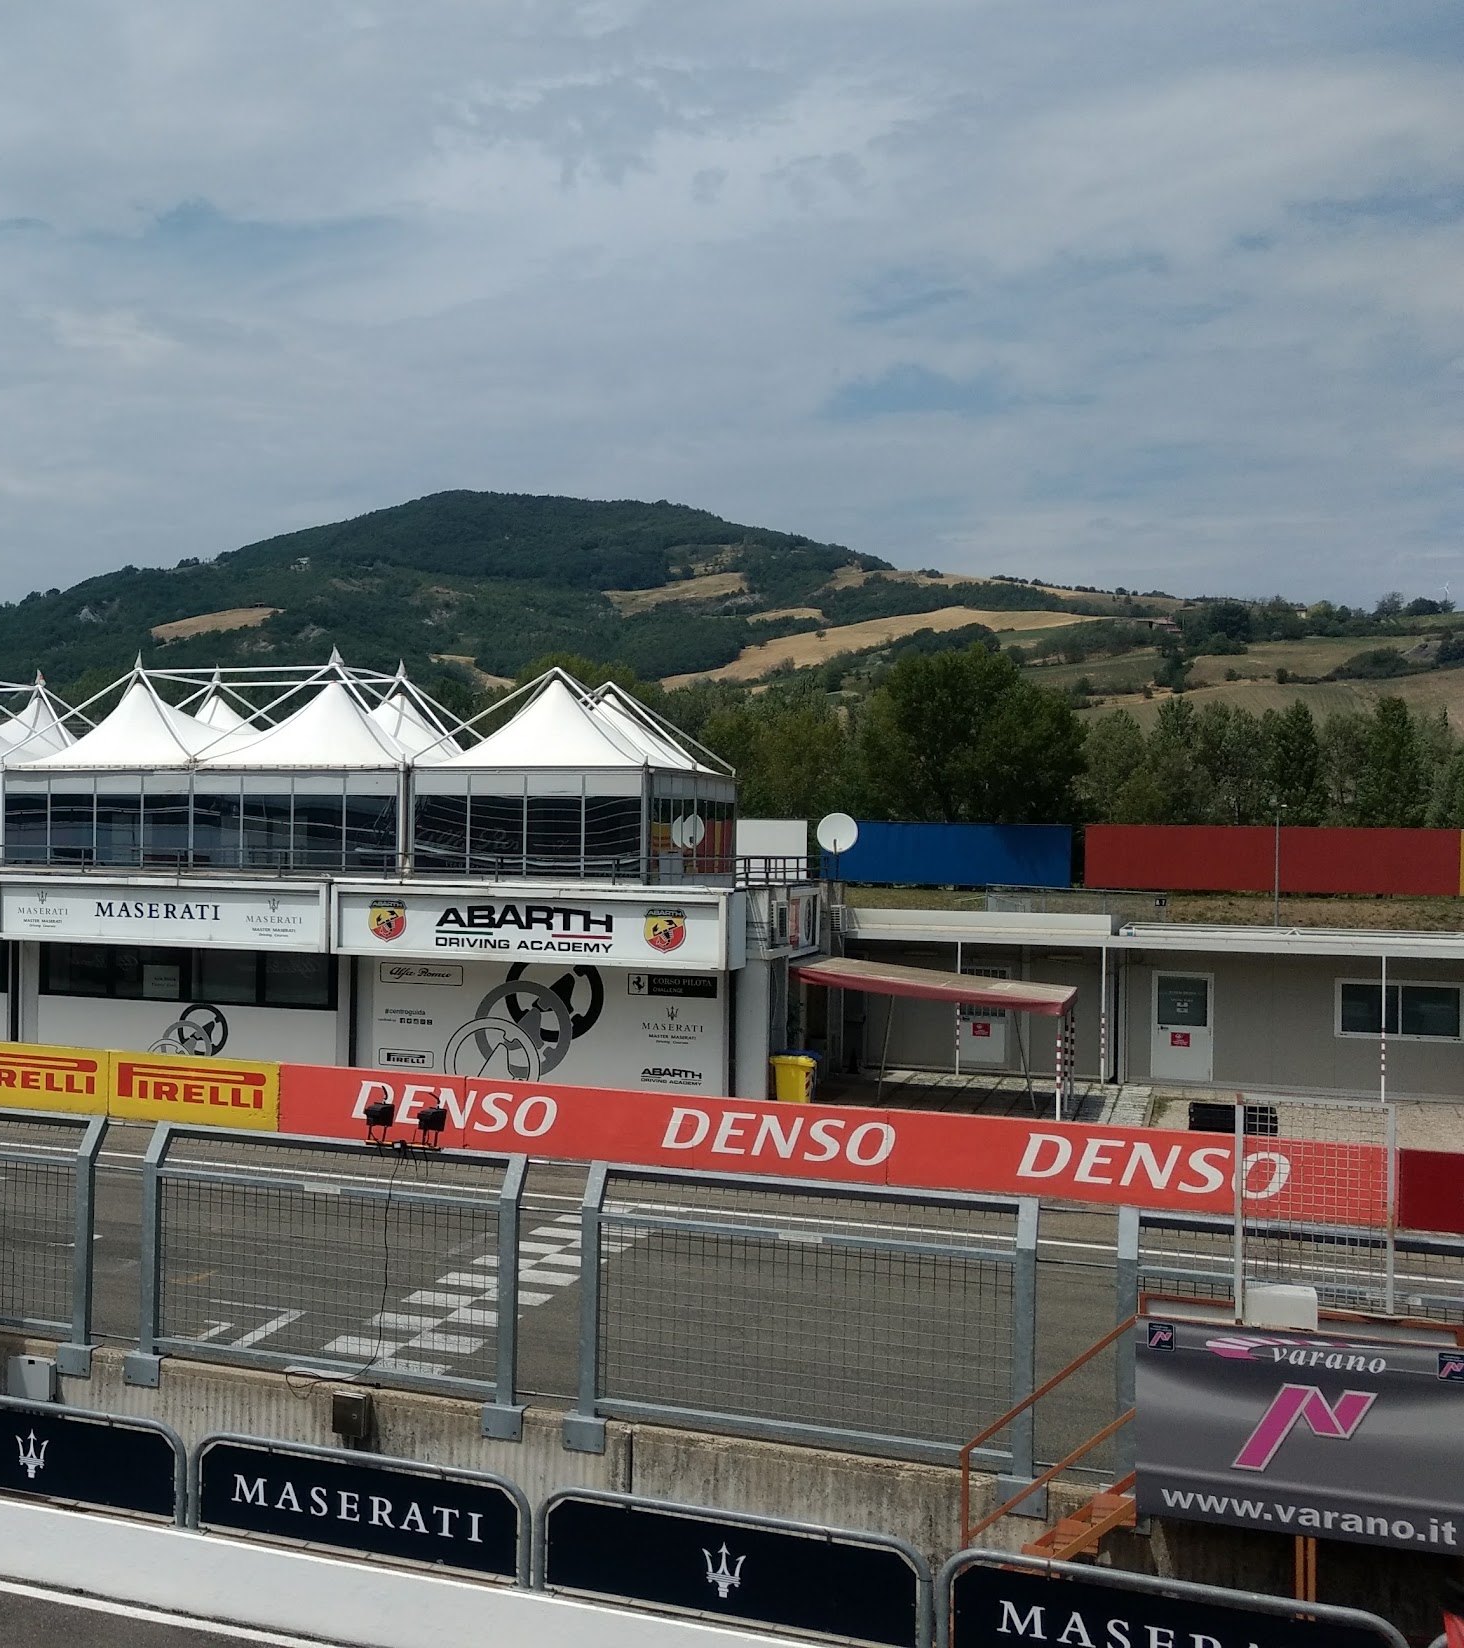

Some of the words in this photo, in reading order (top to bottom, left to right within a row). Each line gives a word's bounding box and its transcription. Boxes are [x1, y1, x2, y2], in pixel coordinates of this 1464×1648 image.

[17, 907, 68, 916] MASERATI
[94, 901, 221, 921] MASERATI
[372, 900, 404, 908] ABARTH
[245, 915, 302, 925] MASERATI
[435, 905, 613, 933] ABARTH
[647, 909, 682, 918] ABARTH
[435, 937, 510, 949] DRIVING
[517, 940, 613, 953] ACADEMY
[389, 966, 416, 980] Alfa
[417, 967, 452, 978] Romeo
[653, 977, 681, 985] CORSO
[682, 978, 712, 987] PILOTA
[641, 1022, 704, 1033] MASERATI
[386, 1052, 426, 1065] PIRELLI
[641, 1067, 702, 1080] ABARTH
[117, 1062, 267, 1110] PIRELLI
[351, 1080, 558, 1138] DENSO
[661, 1107, 897, 1167] DENSO
[1016, 1132, 1292, 1200] DENSO
[1271, 1347, 1387, 1374] varano
[231, 1472, 486, 1544] MASERATI
[1160, 1487, 1458, 1546] www.varano.it
[996, 1600, 1263, 1648] MASE
